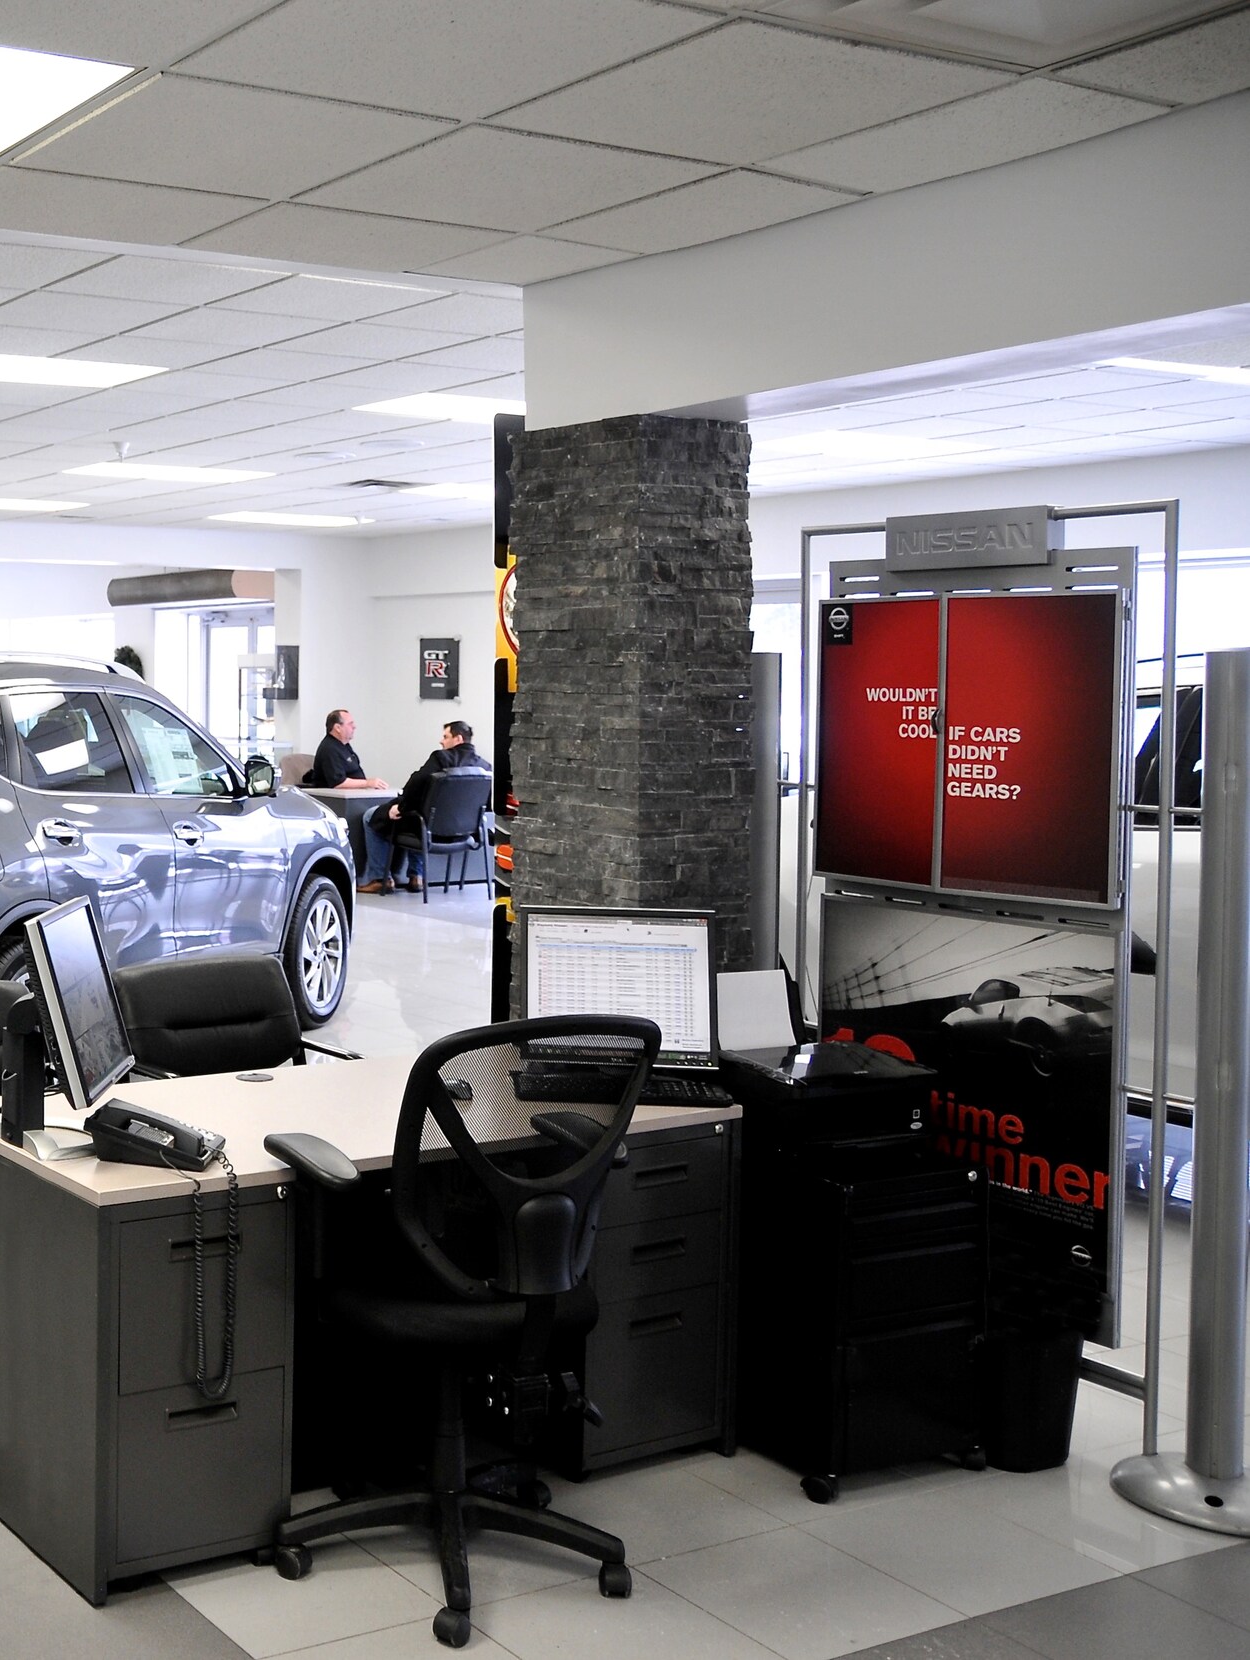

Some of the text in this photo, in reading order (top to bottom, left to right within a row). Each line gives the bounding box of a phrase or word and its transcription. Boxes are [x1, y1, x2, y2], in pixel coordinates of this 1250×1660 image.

[896, 521, 1034, 556] NISSAN
[423, 650, 449, 660] GT
[866, 687, 938, 702] WOULDN'T
[902, 706, 915, 720] IT
[948, 726, 1021, 743] IF CARS
[948, 744, 1008, 761] DIDN'T
[947, 763, 997, 780] NEED
[946, 781, 1021, 800] GEARS?
[930, 1089, 1025, 1145] time
